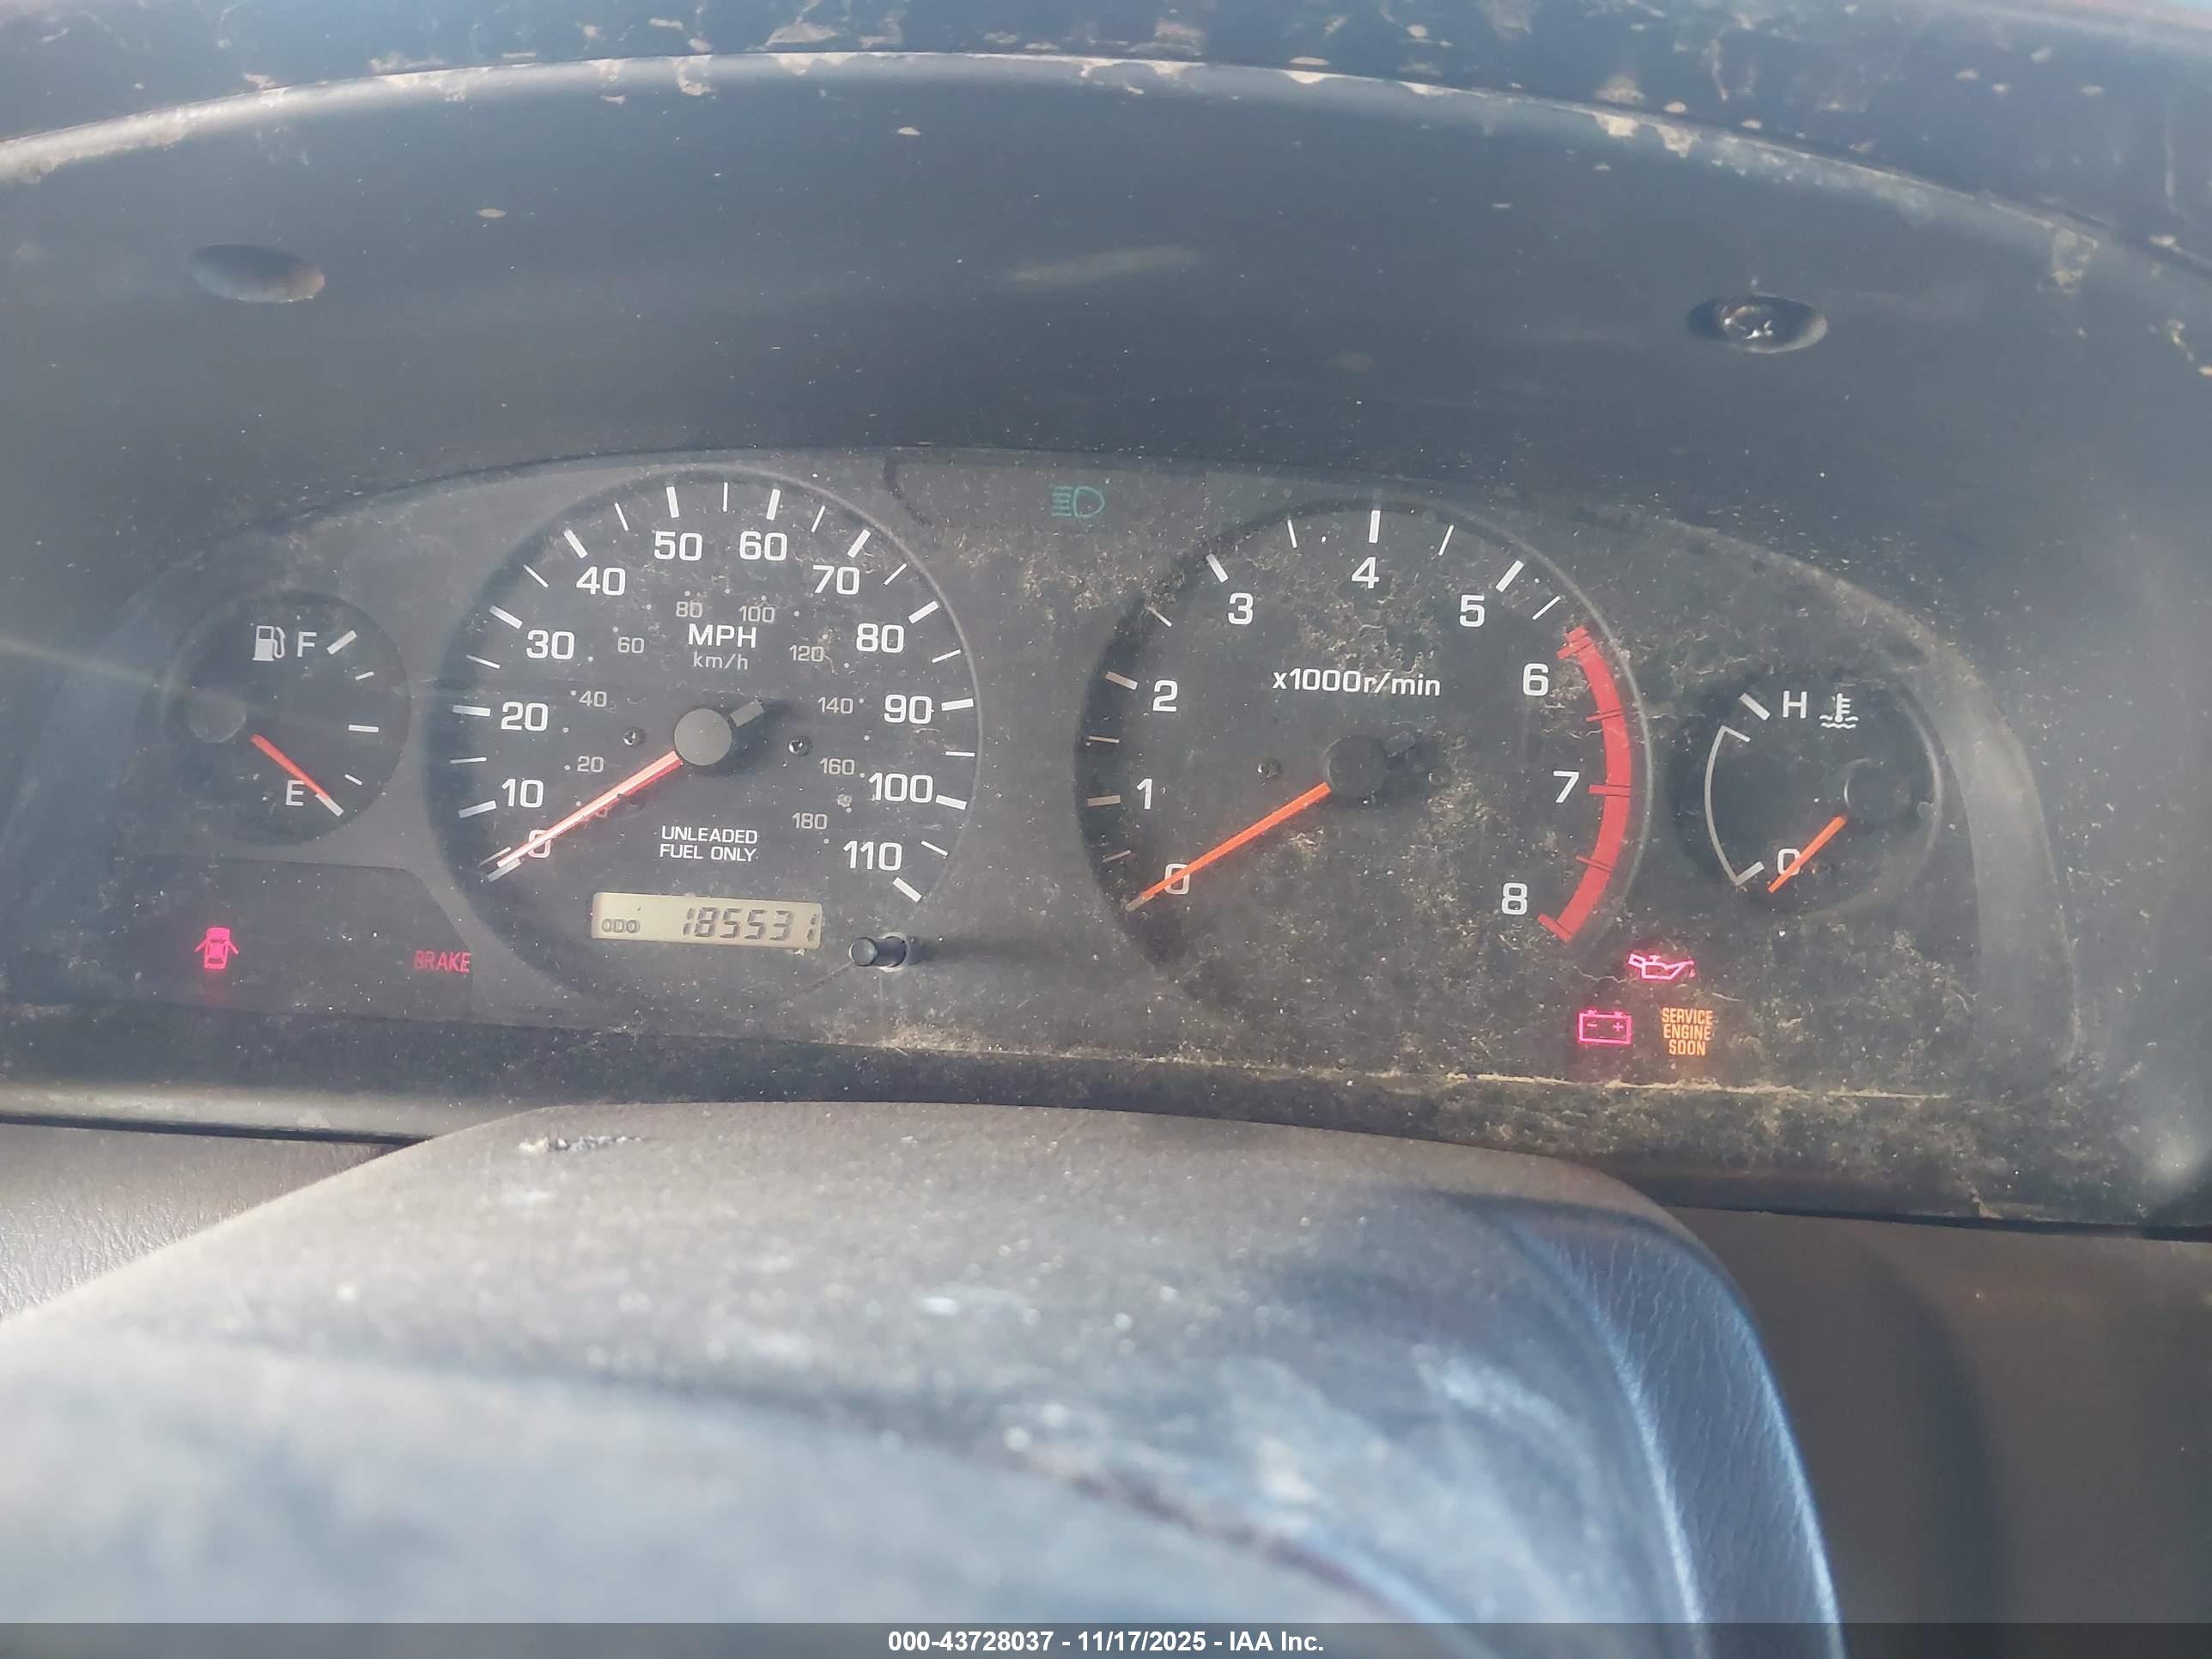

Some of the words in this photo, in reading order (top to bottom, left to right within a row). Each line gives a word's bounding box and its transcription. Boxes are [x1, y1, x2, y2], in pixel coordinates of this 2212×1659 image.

[654, 531, 702, 562] 50
[738, 531, 787, 562] 60
[575, 567, 625, 596] 40
[812, 565, 860, 594] 70
[1352, 556, 1379, 589] 4
[676, 602, 702, 619] 80
[738, 605, 775, 623] 100
[1228, 592, 1254, 625] 3
[1460, 594, 1486, 627] 5
[297, 632, 318, 658] F
[526, 630, 575, 659] 30
[618, 637, 644, 653] 60
[688, 625, 757, 648] MPH
[857, 623, 903, 653] 80
[694, 651, 747, 670] km/h
[790, 644, 824, 661] 120
[1272, 669, 1440, 696] x1000r/min
[1523, 663, 1549, 696] 6
[579, 690, 606, 708] 40
[817, 697, 854, 714] 140
[1152, 680, 1178, 711] 2
[1783, 690, 1807, 718] H
[501, 701, 548, 732] 20
[884, 695, 933, 725] 90
[577, 756, 605, 773] 20
[819, 757, 855, 775] 160
[285, 780, 305, 806] E
[501, 778, 544, 807] 10
[869, 773, 933, 804] 100
[1137, 778, 1152, 809] 1
[1553, 771, 1580, 804] 7
[792, 812, 828, 830] 180
[660, 825, 758, 845] UNLEADED
[659, 844, 705, 860] FUEL
[711, 847, 757, 862] ONLY
[843, 840, 902, 871] 110
[1164, 864, 1189, 894] 0
[1501, 883, 1527, 915] 8
[601, 919, 640, 933] ODO
[414, 950, 471, 972] BRAKE
[1662, 1007, 1713, 1024] SERVICE
[1663, 1024, 1711, 1041] ENGINE
[1669, 1039, 1706, 1055] SOON
